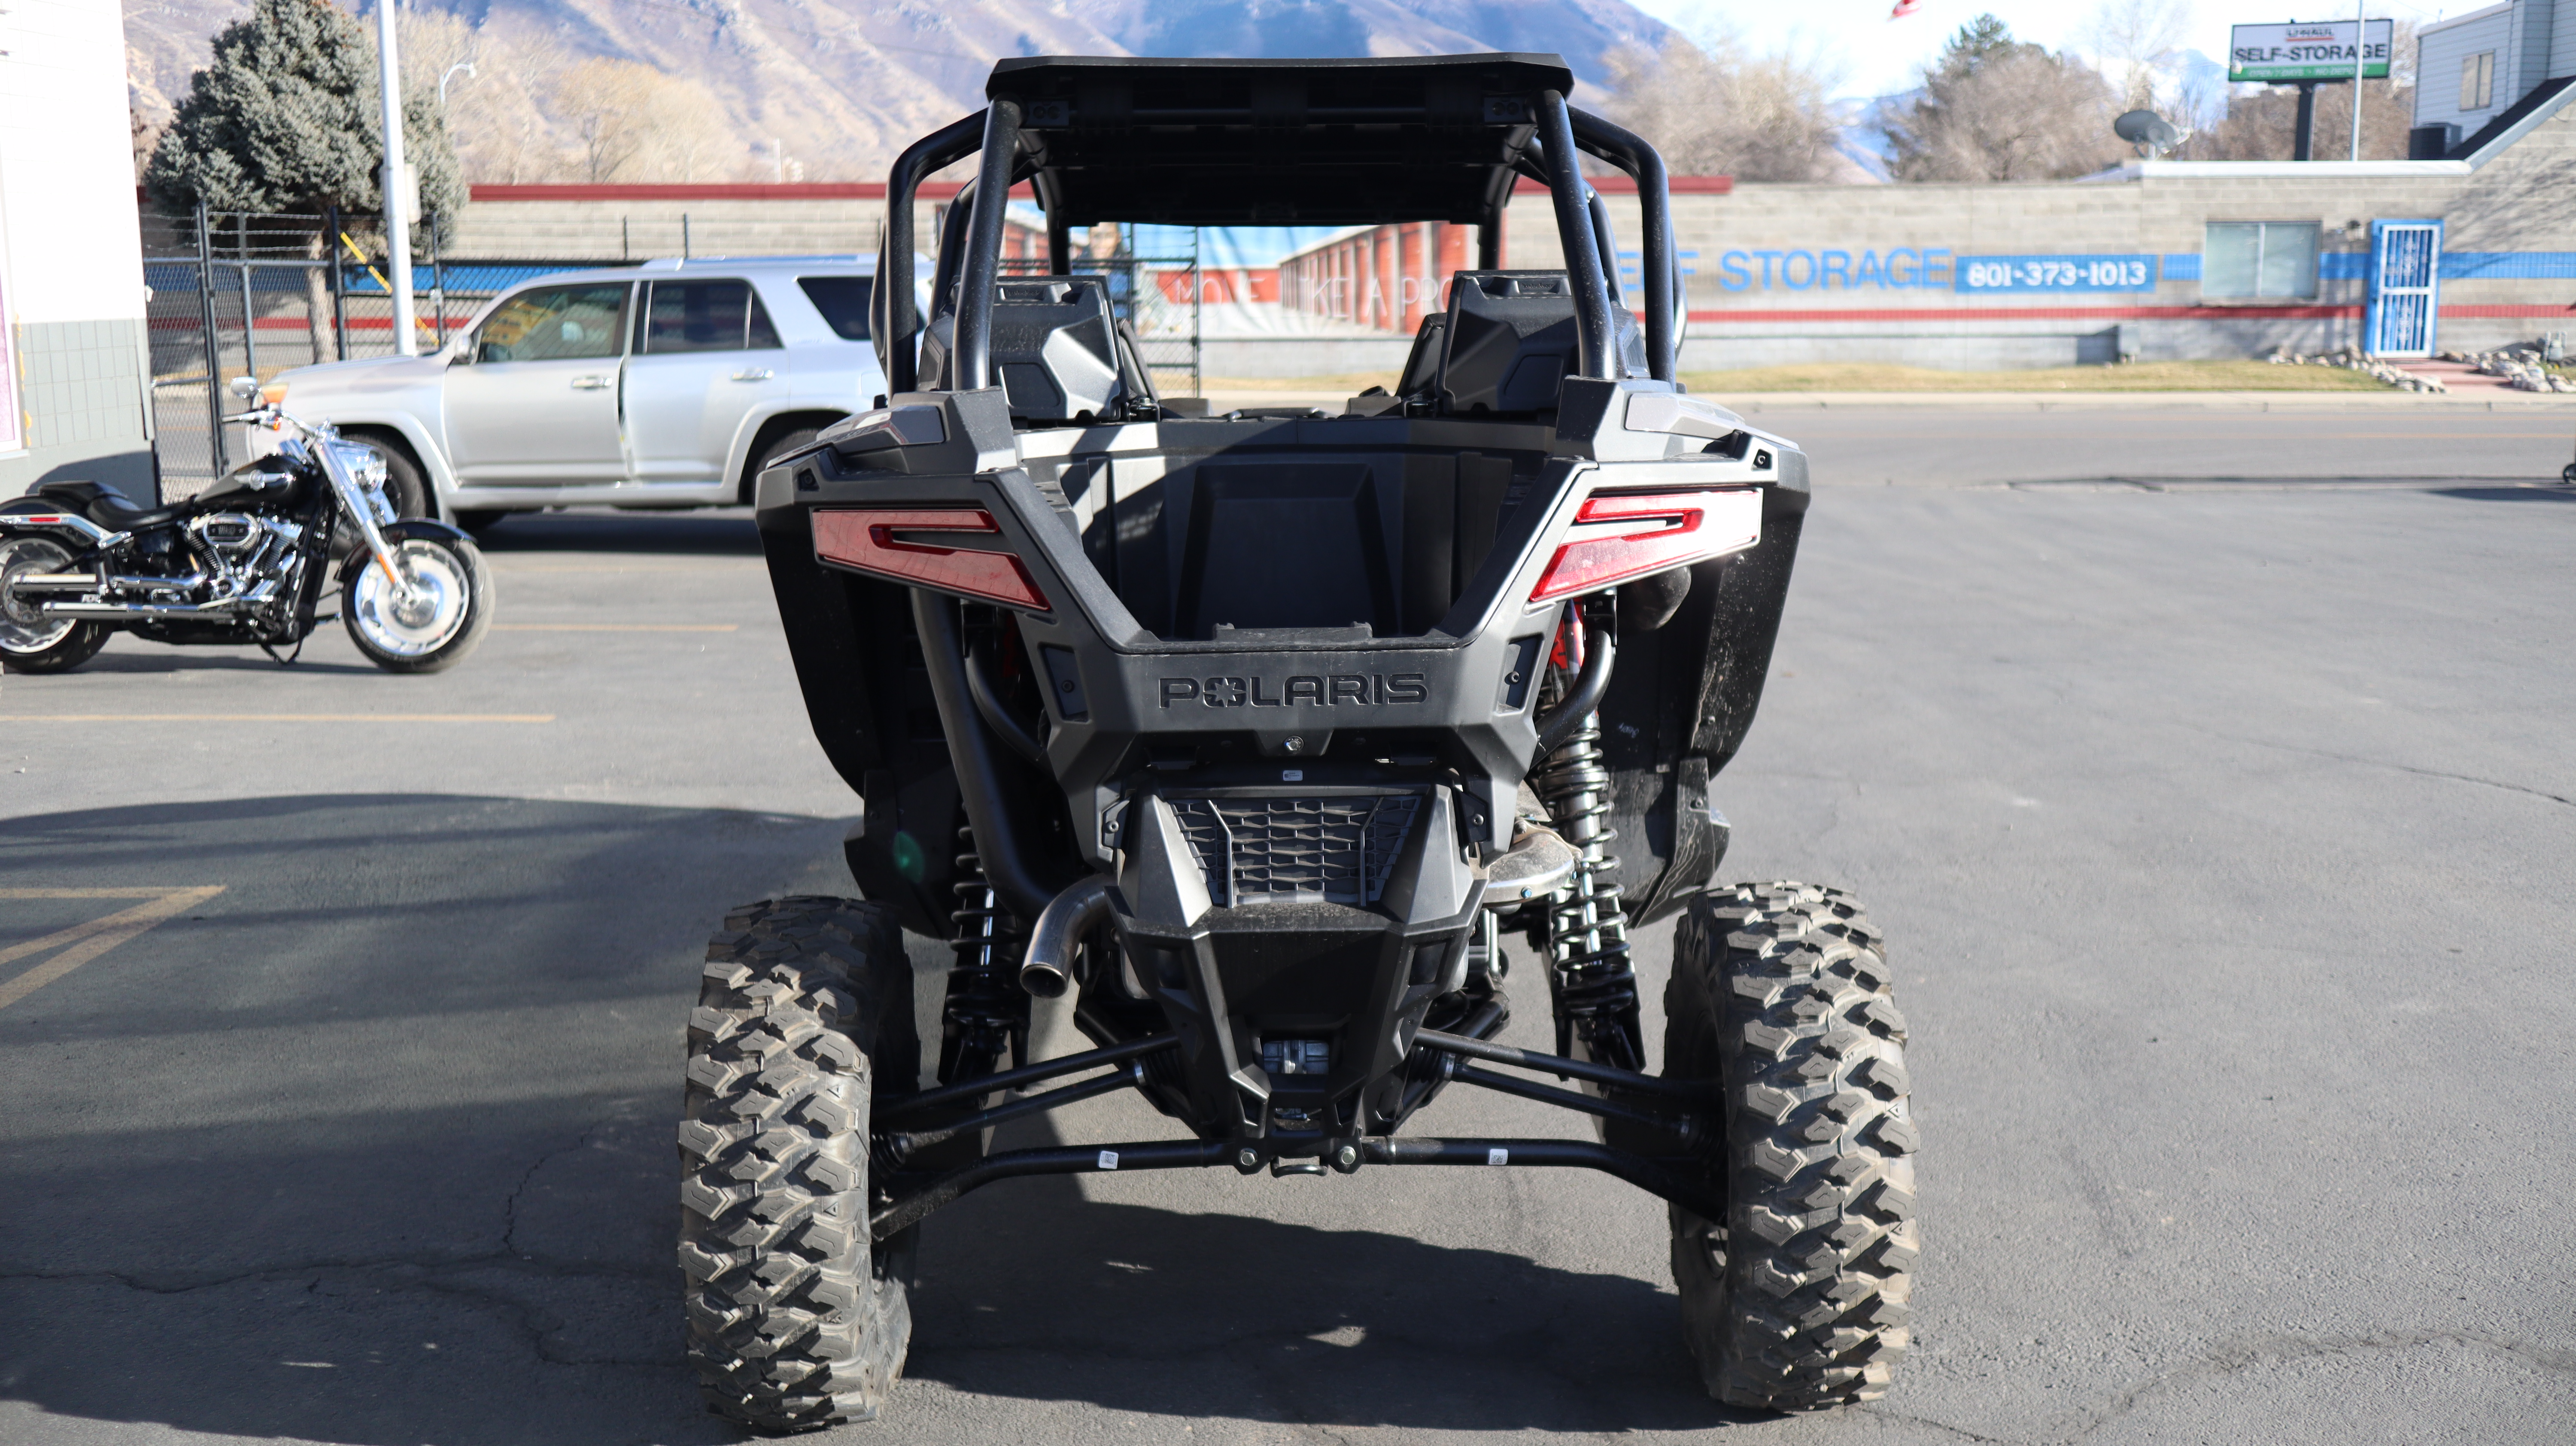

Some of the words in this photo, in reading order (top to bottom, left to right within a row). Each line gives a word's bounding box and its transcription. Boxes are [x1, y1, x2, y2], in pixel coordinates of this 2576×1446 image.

[2235, 44, 2387, 61] SELF-STORAGE
[1719, 248, 1951, 292] STORAGE
[1967, 261, 2147, 287] 801-373-1013
[1364, 276, 1388, 318] A
[1159, 673, 1428, 708] POLARIS
